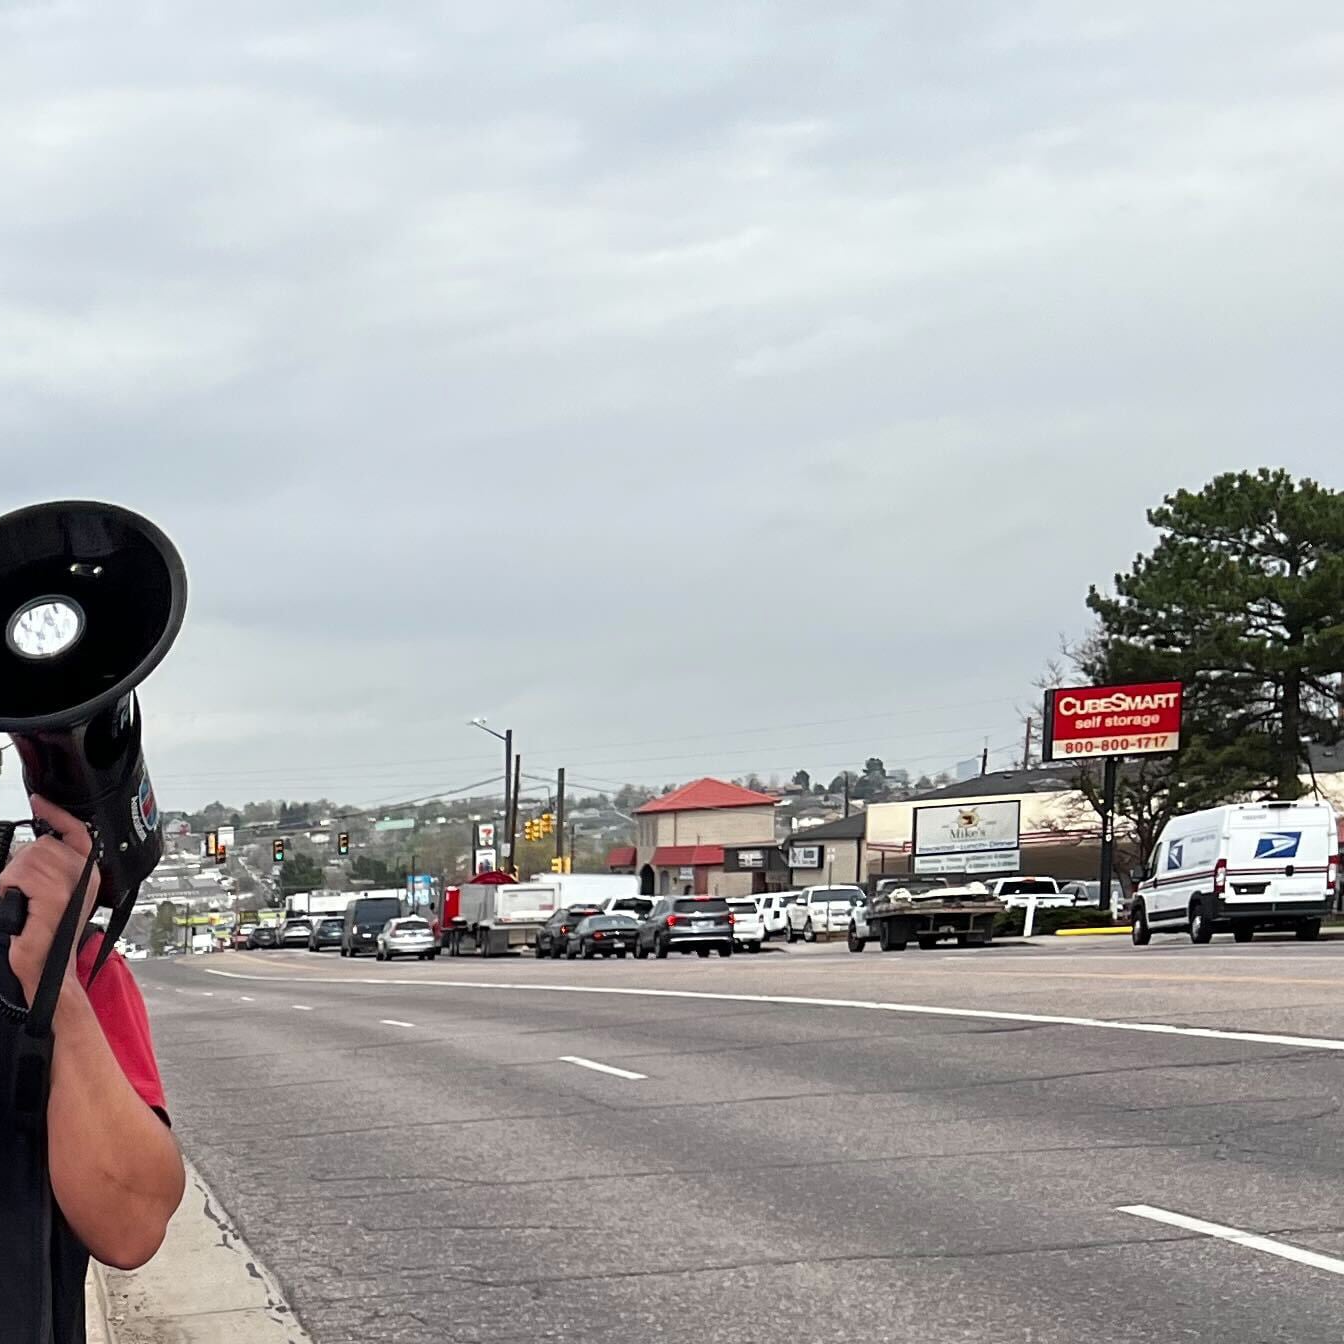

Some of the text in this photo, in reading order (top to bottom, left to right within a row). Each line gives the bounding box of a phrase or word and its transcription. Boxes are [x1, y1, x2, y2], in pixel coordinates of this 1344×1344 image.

[1075, 714, 1160, 729] self storage
[1065, 735, 1168, 754] 800-800-1717
[950, 828, 986, 839] Mike's
